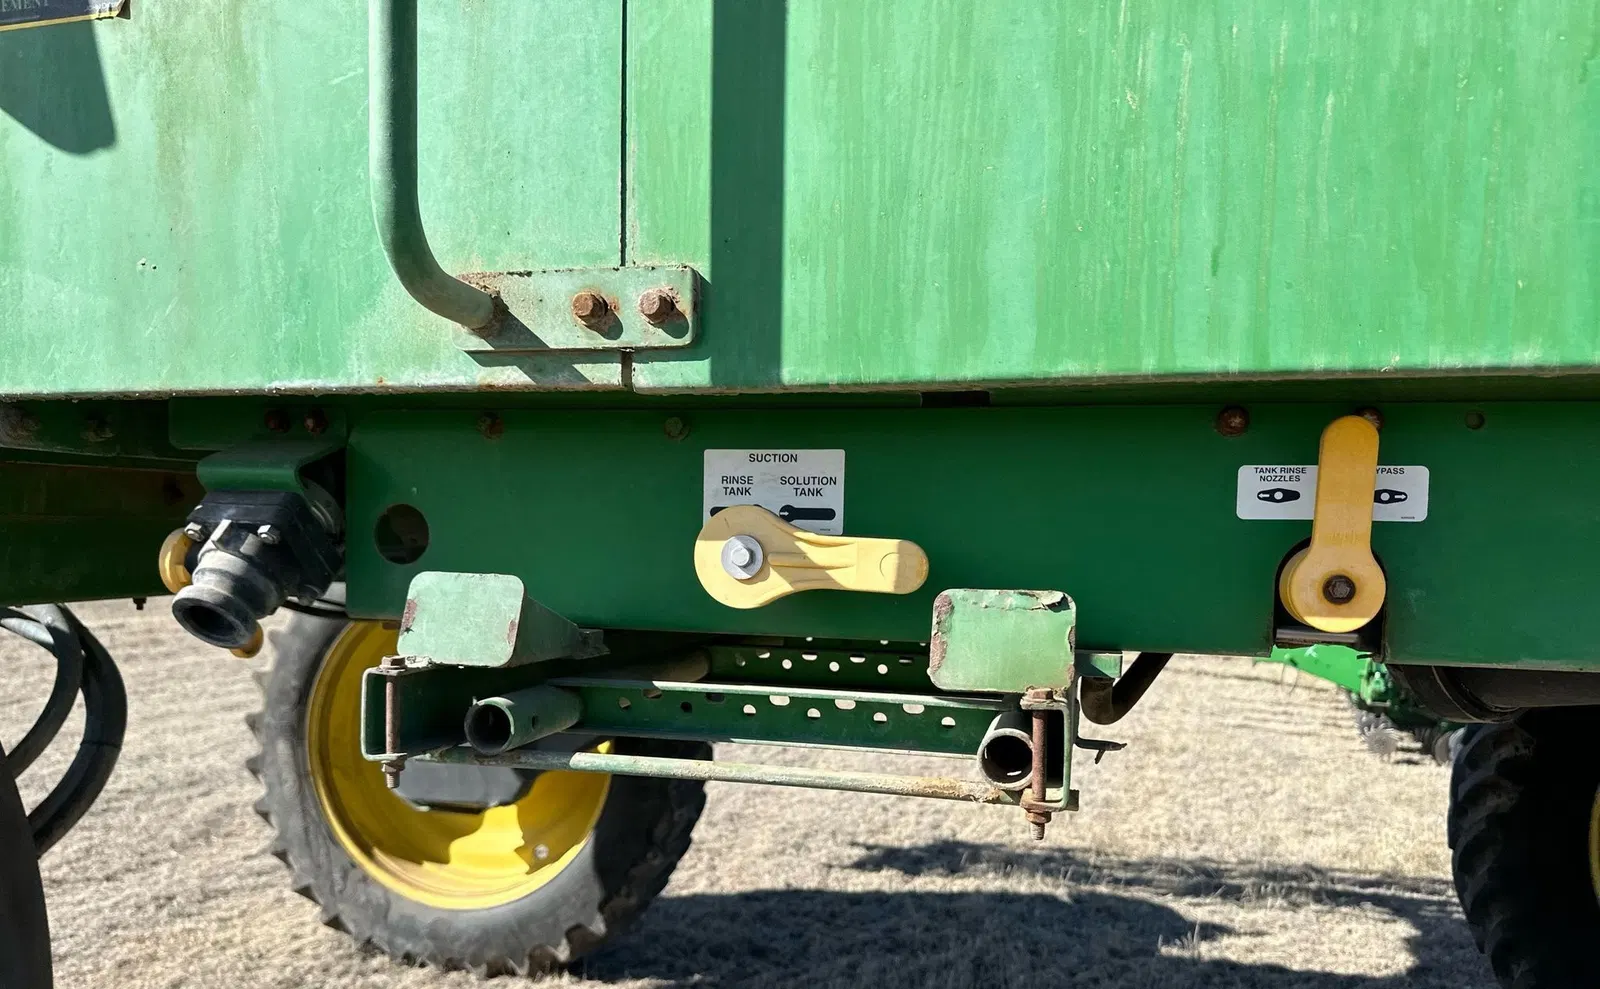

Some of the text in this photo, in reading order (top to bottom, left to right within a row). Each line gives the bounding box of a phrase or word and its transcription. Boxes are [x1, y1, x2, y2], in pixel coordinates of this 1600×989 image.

[748, 453, 798, 463] SUCTION
[1376, 467, 1405, 475] YPASS
[721, 475, 754, 485] RINSE
[779, 476, 837, 486] SOLUTION
[723, 486, 752, 496] TANK
[793, 487, 823, 497] TANK
